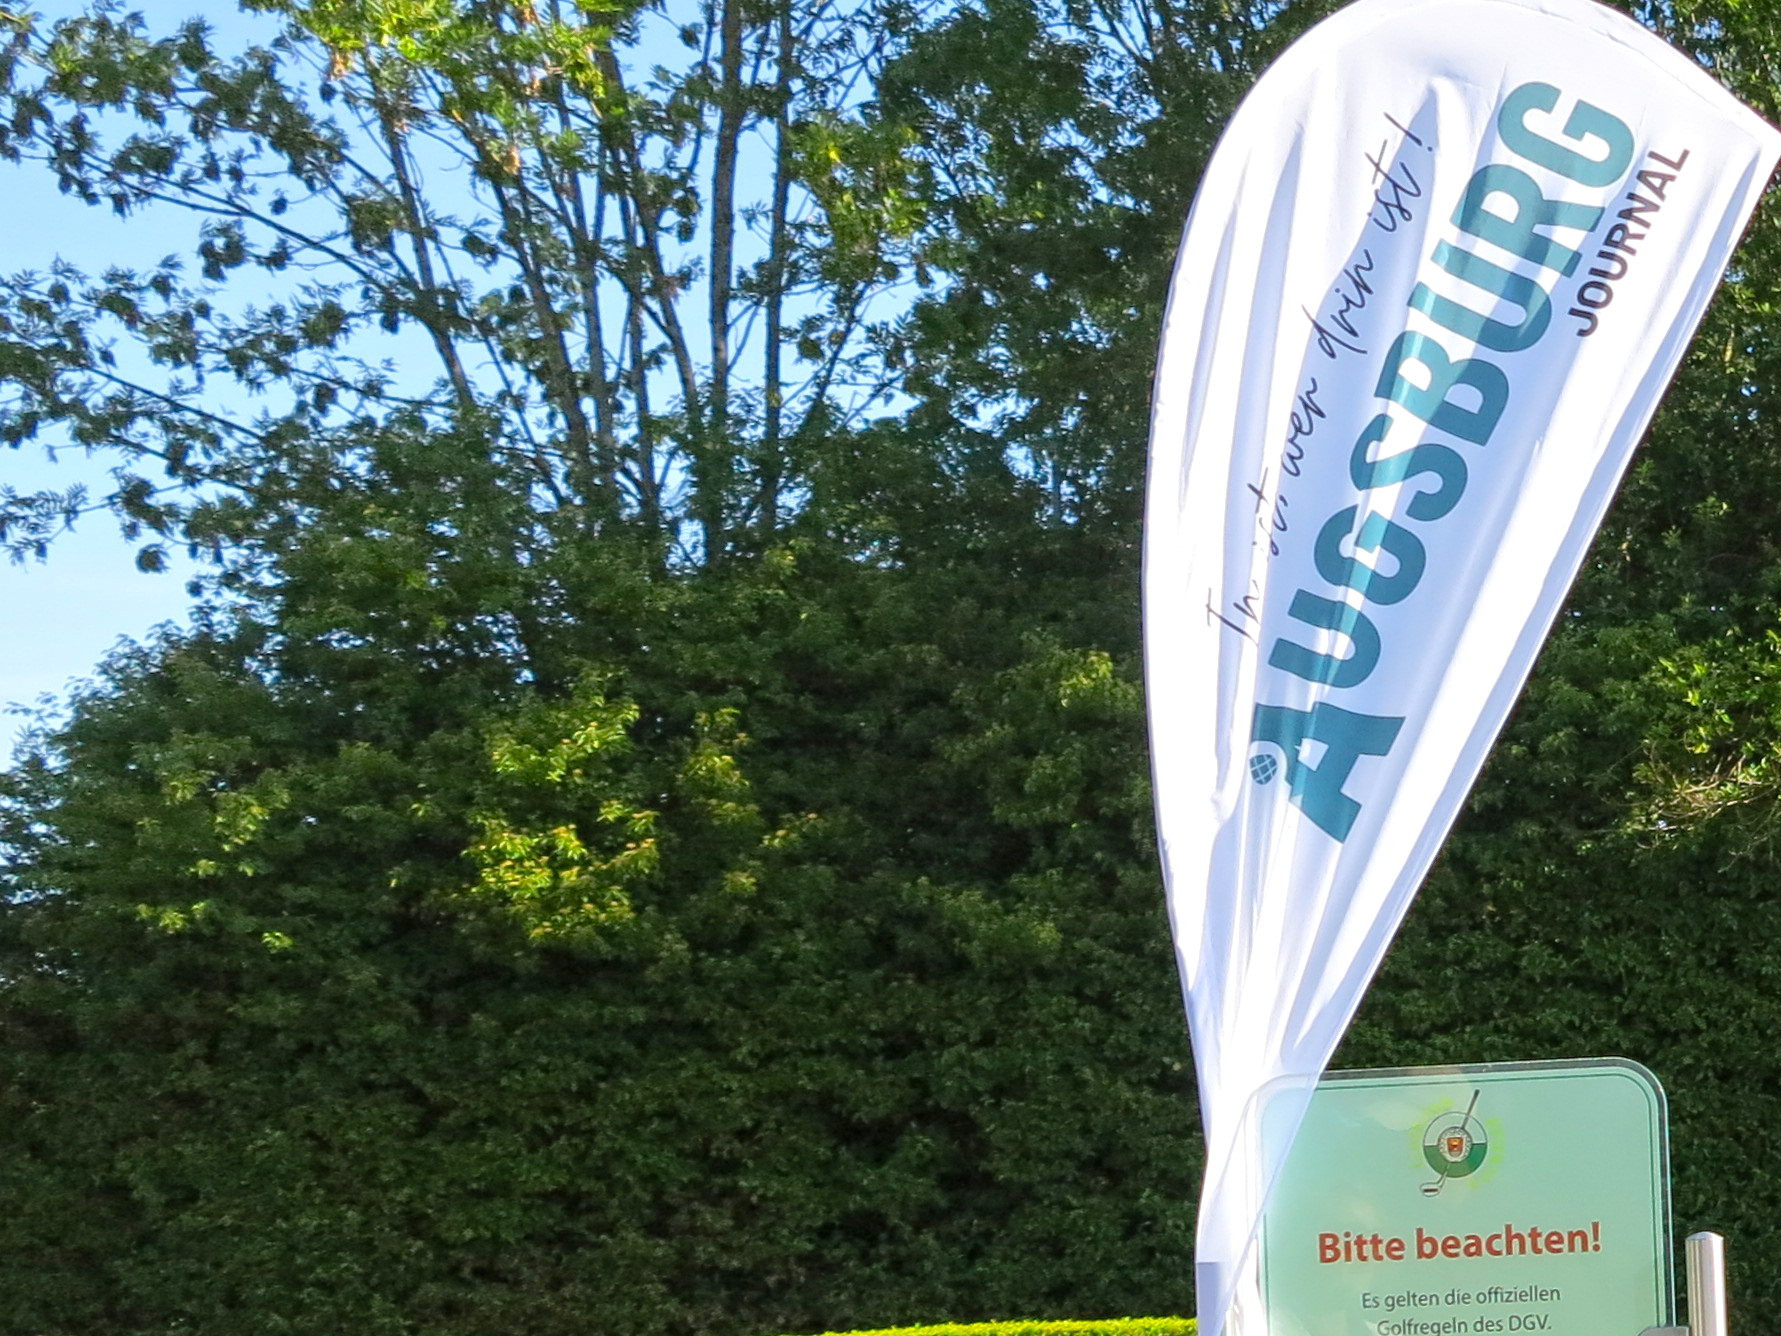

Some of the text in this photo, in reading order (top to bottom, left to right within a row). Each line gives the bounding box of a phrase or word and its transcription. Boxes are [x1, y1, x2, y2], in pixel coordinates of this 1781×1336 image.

[1568, 144, 1690, 338] JOURNAL
[1302, 248, 1375, 356] drin
[1251, 81, 1637, 844] AUGSBURG
[1282, 377, 1327, 478] wer
[1318, 1221, 1601, 1264] Bitte beachten!
[1361, 1285, 1561, 1312] Es gelten die offiziellen
[1473, 1317, 1504, 1333] des
[1508, 1314, 1552, 1332] DGV.
